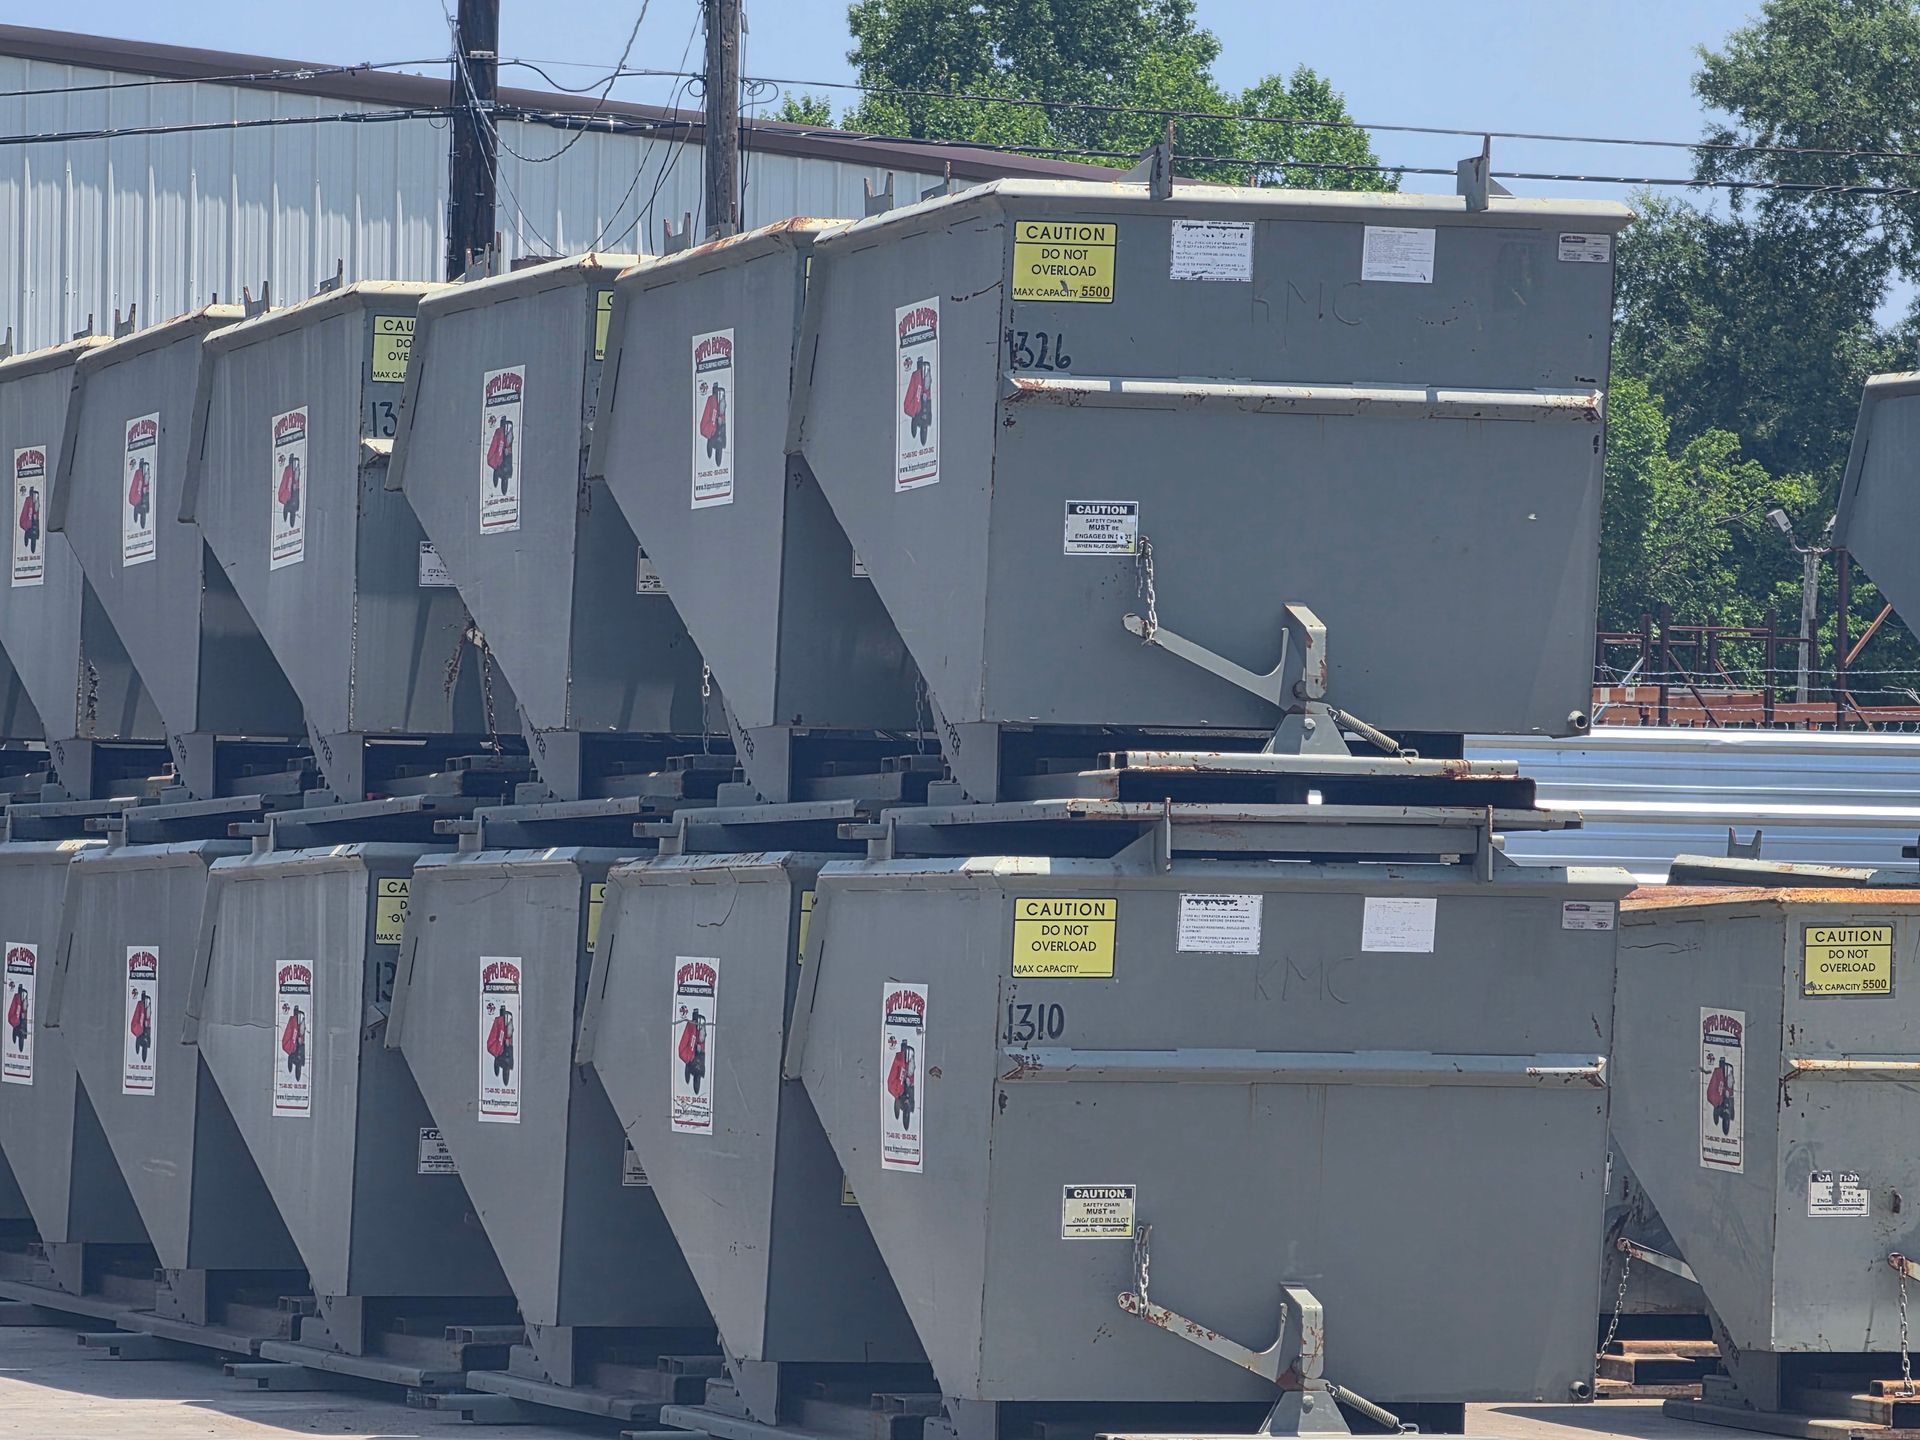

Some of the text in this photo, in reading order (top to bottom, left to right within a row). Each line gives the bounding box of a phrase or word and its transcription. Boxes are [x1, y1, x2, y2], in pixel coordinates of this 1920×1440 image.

[1026, 225, 1105, 241] CAUTION
[1041, 248, 1089, 260] DO NOT
[1031, 264, 1097, 277] OVERLOAD
[1013, 285, 1110, 297] MAX CAPACITY 5500
[1076, 505, 1128, 514] CAUTION
[1026, 902, 1105, 916] CAUTION
[1041, 924, 1089, 936] DO NOT
[1815, 930, 1882, 942] CAUTION
[376, 933, 394, 941] MAX
[1031, 940, 1097, 952] OVERLOAD
[1828, 949, 1869, 959] DO NOT
[1013, 964, 1079, 973] MAX CAPACITY
[1820, 963, 1876, 972] OVERLOAD
[1825, 983, 1861, 991] CAPACITY
[1862, 979, 1887, 989] 5500
[1006, 1003, 1066, 1045] 1310
[1817, 1174, 1860, 1182] CATION
[1074, 1189, 1125, 1198] CAUTION
